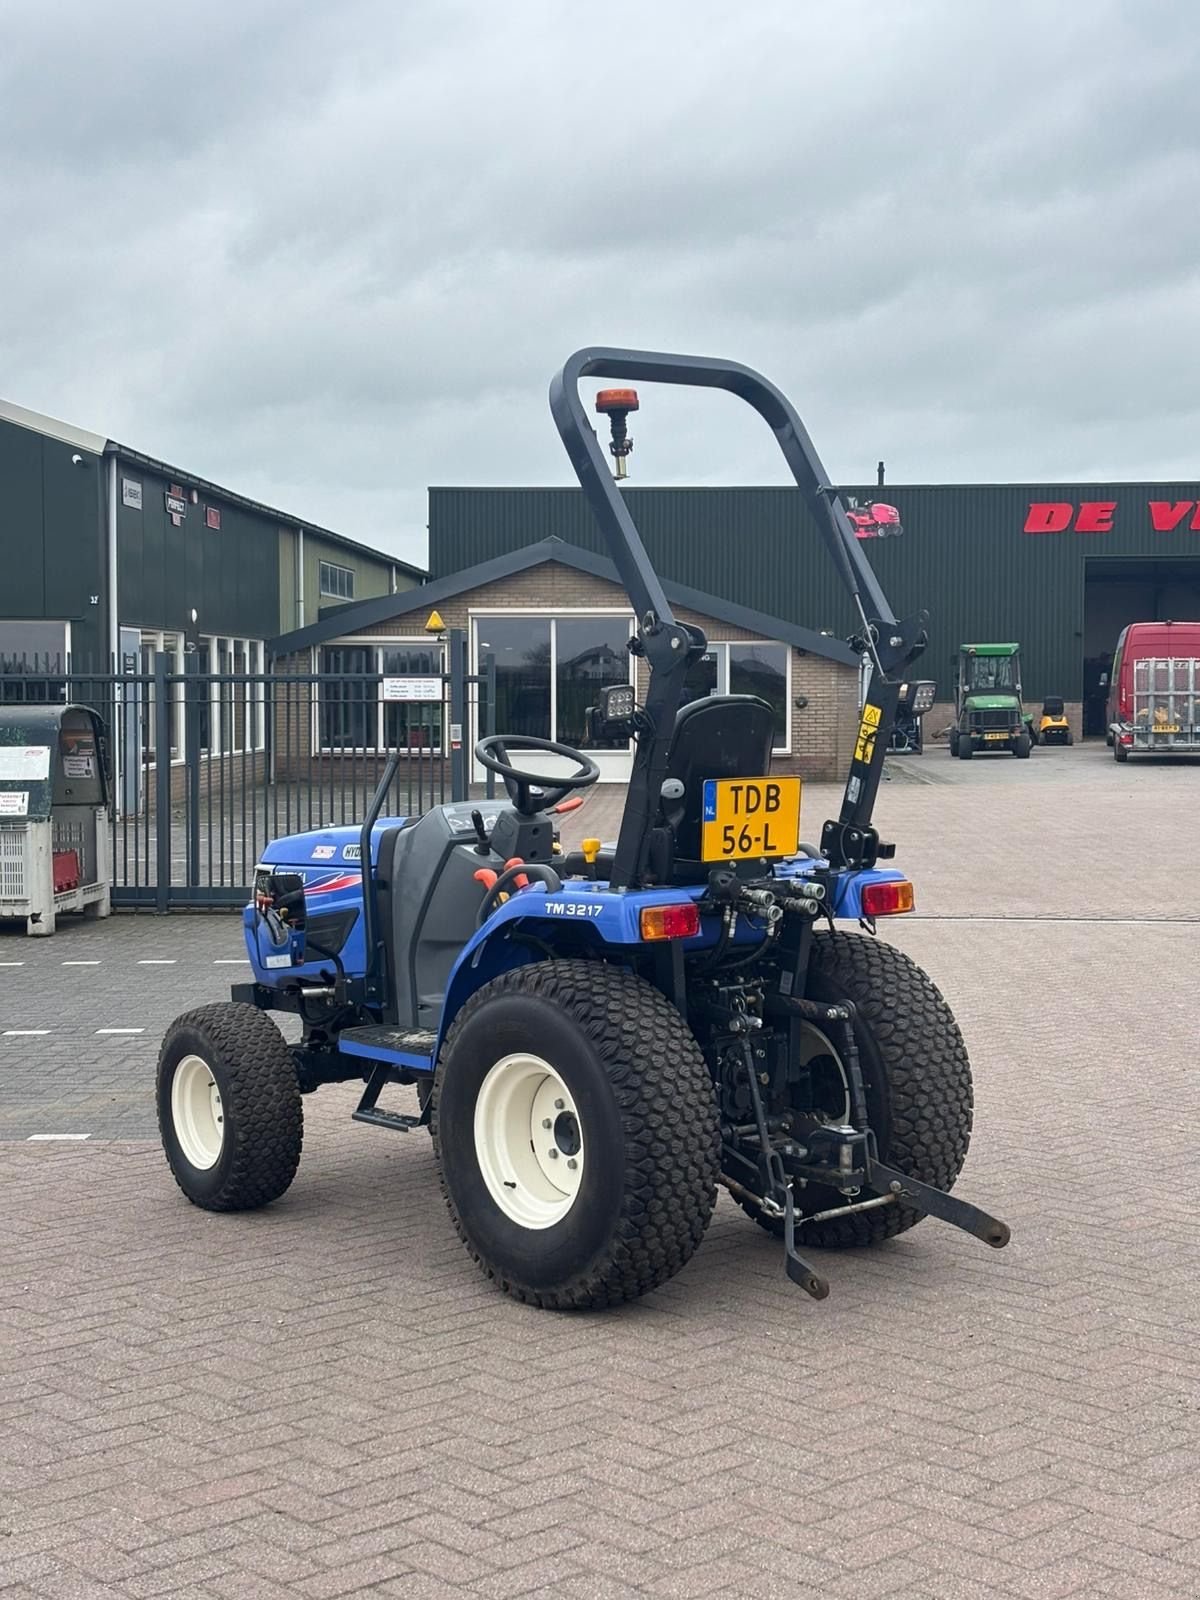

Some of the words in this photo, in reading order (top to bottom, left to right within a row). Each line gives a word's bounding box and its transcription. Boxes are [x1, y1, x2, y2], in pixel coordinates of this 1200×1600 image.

[1023, 502, 1117, 533] DE
[1149, 502, 1200, 531] V
[705, 806, 715, 815] NL
[730, 784, 781, 814] TDB
[722, 823, 777, 854] 56-L
